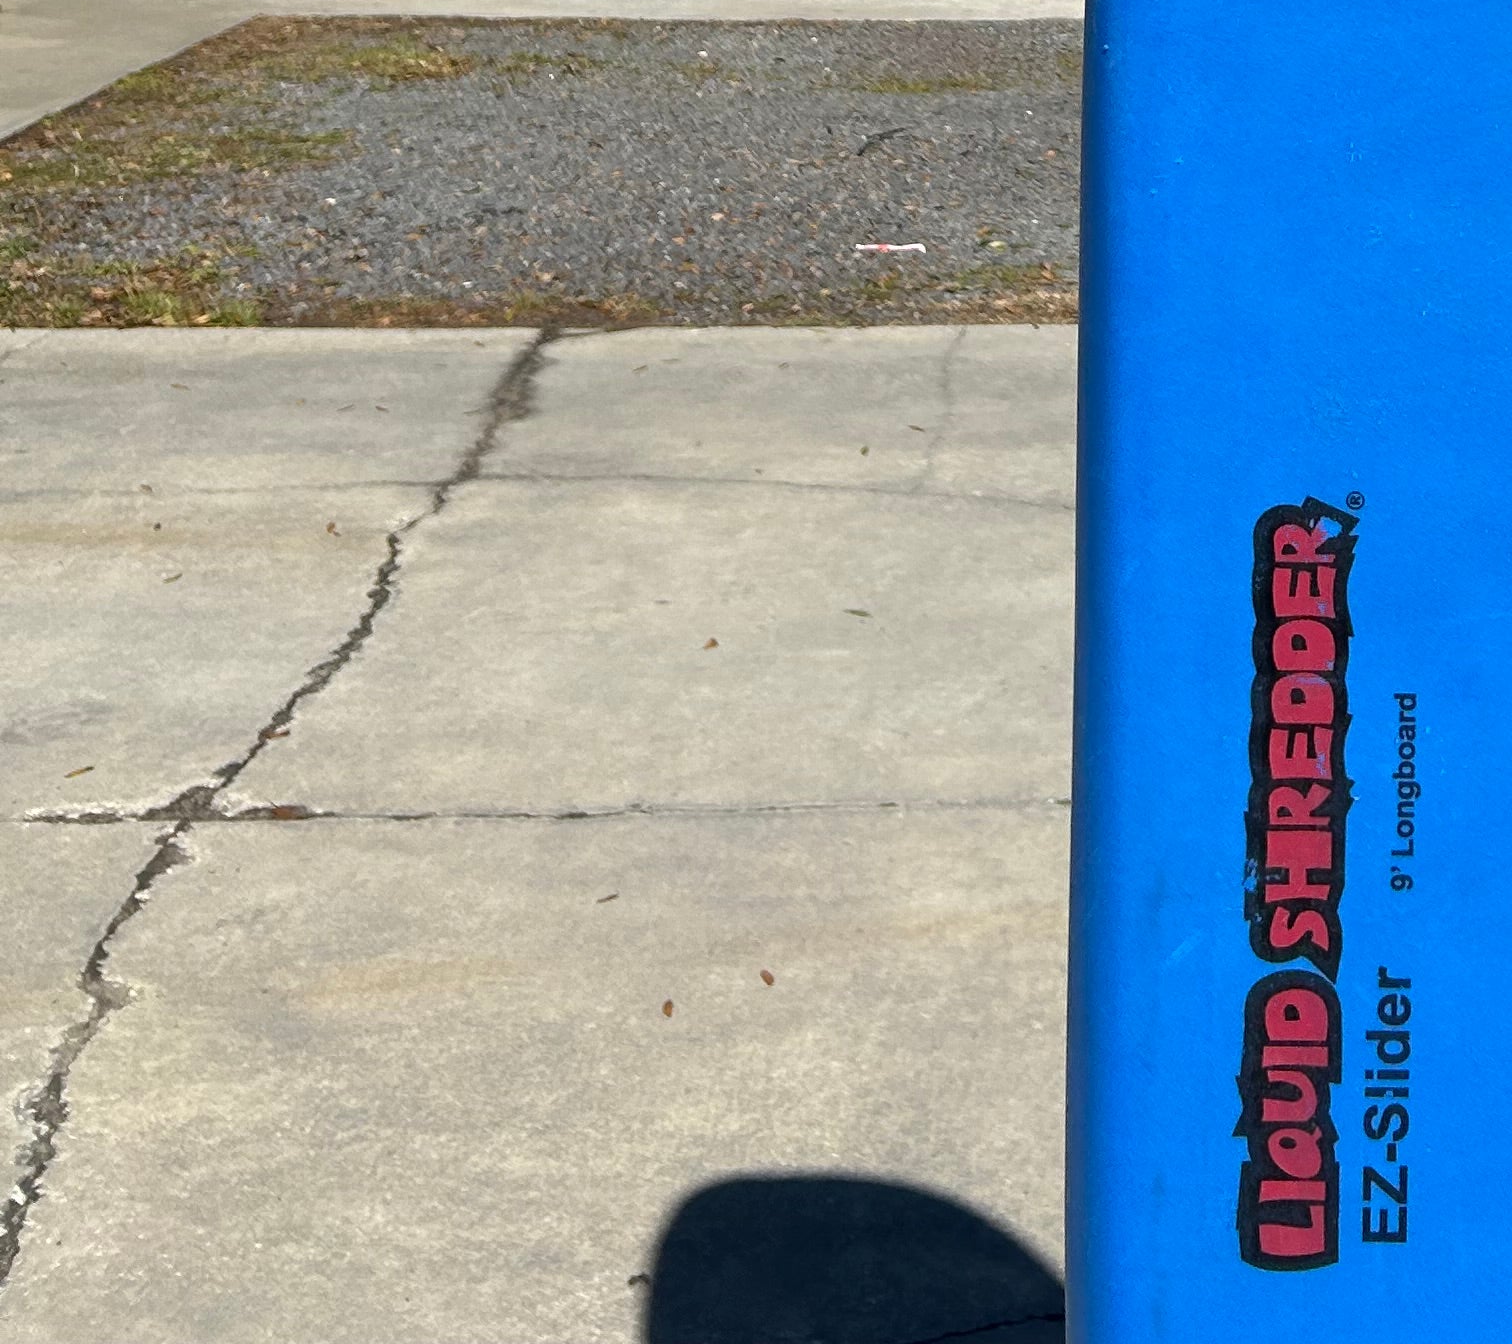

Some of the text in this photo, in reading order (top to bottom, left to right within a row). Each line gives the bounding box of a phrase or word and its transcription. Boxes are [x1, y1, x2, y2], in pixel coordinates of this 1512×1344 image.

[1253, 513, 1345, 1261] LIQUID SHREDDER
[1390, 692, 1422, 858] Longboard
[1361, 965, 1412, 1244] EZ-Slider
